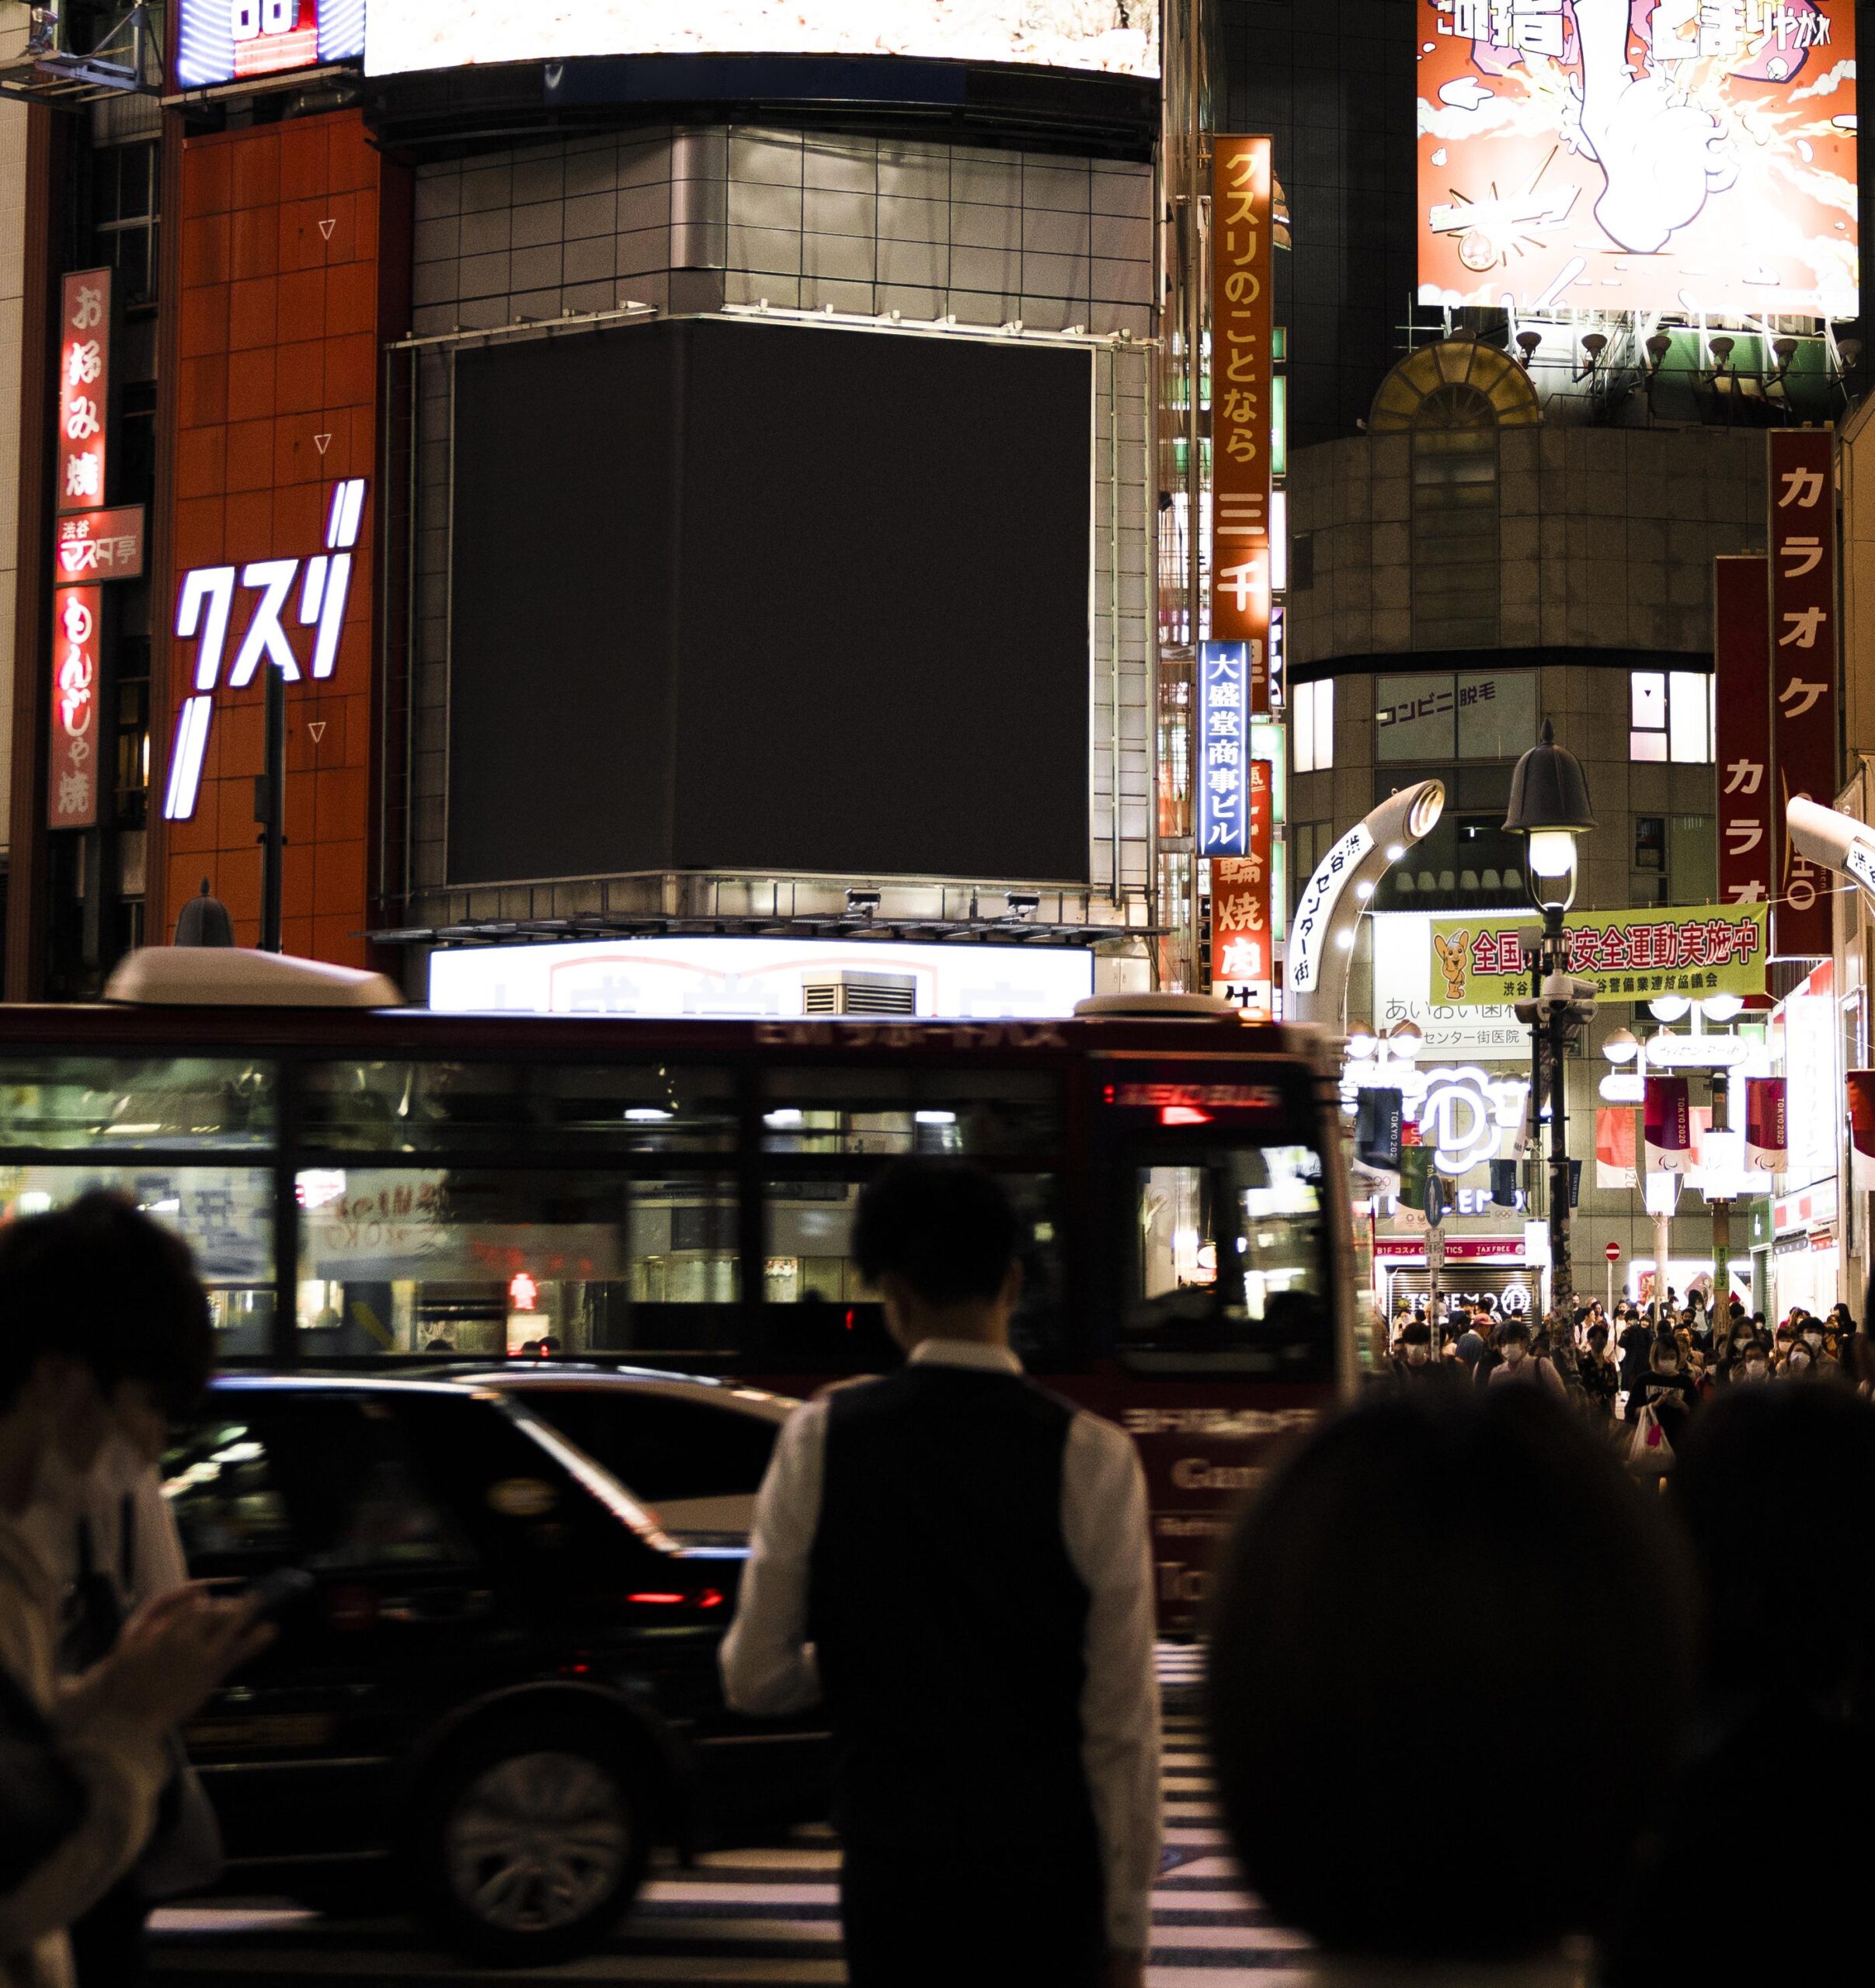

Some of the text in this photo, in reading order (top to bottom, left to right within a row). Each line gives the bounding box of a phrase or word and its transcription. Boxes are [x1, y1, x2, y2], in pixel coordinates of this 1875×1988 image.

[1225, 154, 1260, 464] クスリのことなら
[66, 286, 102, 496] お好み焼
[62, 520, 89, 540] 渋谷
[1778, 467, 1828, 718] カラオケ
[58, 596, 93, 815] もんじゃ焼
[1207, 652, 1241, 846] 大盛堂商事ビル
[1293, 834, 1361, 985] 渋谷センター街
[1472, 918, 1758, 975] 全国安全運動実施中
[1587, 973, 1718, 995] 谷警備業連絡協議会
[1424, 1029, 1520, 1044] センター街医院
[1390, 1110, 1399, 1142] TOKYO
[1678, 1124, 1686, 1145] 2020
[1776, 1097, 1785, 1145] TOKYO 2020
